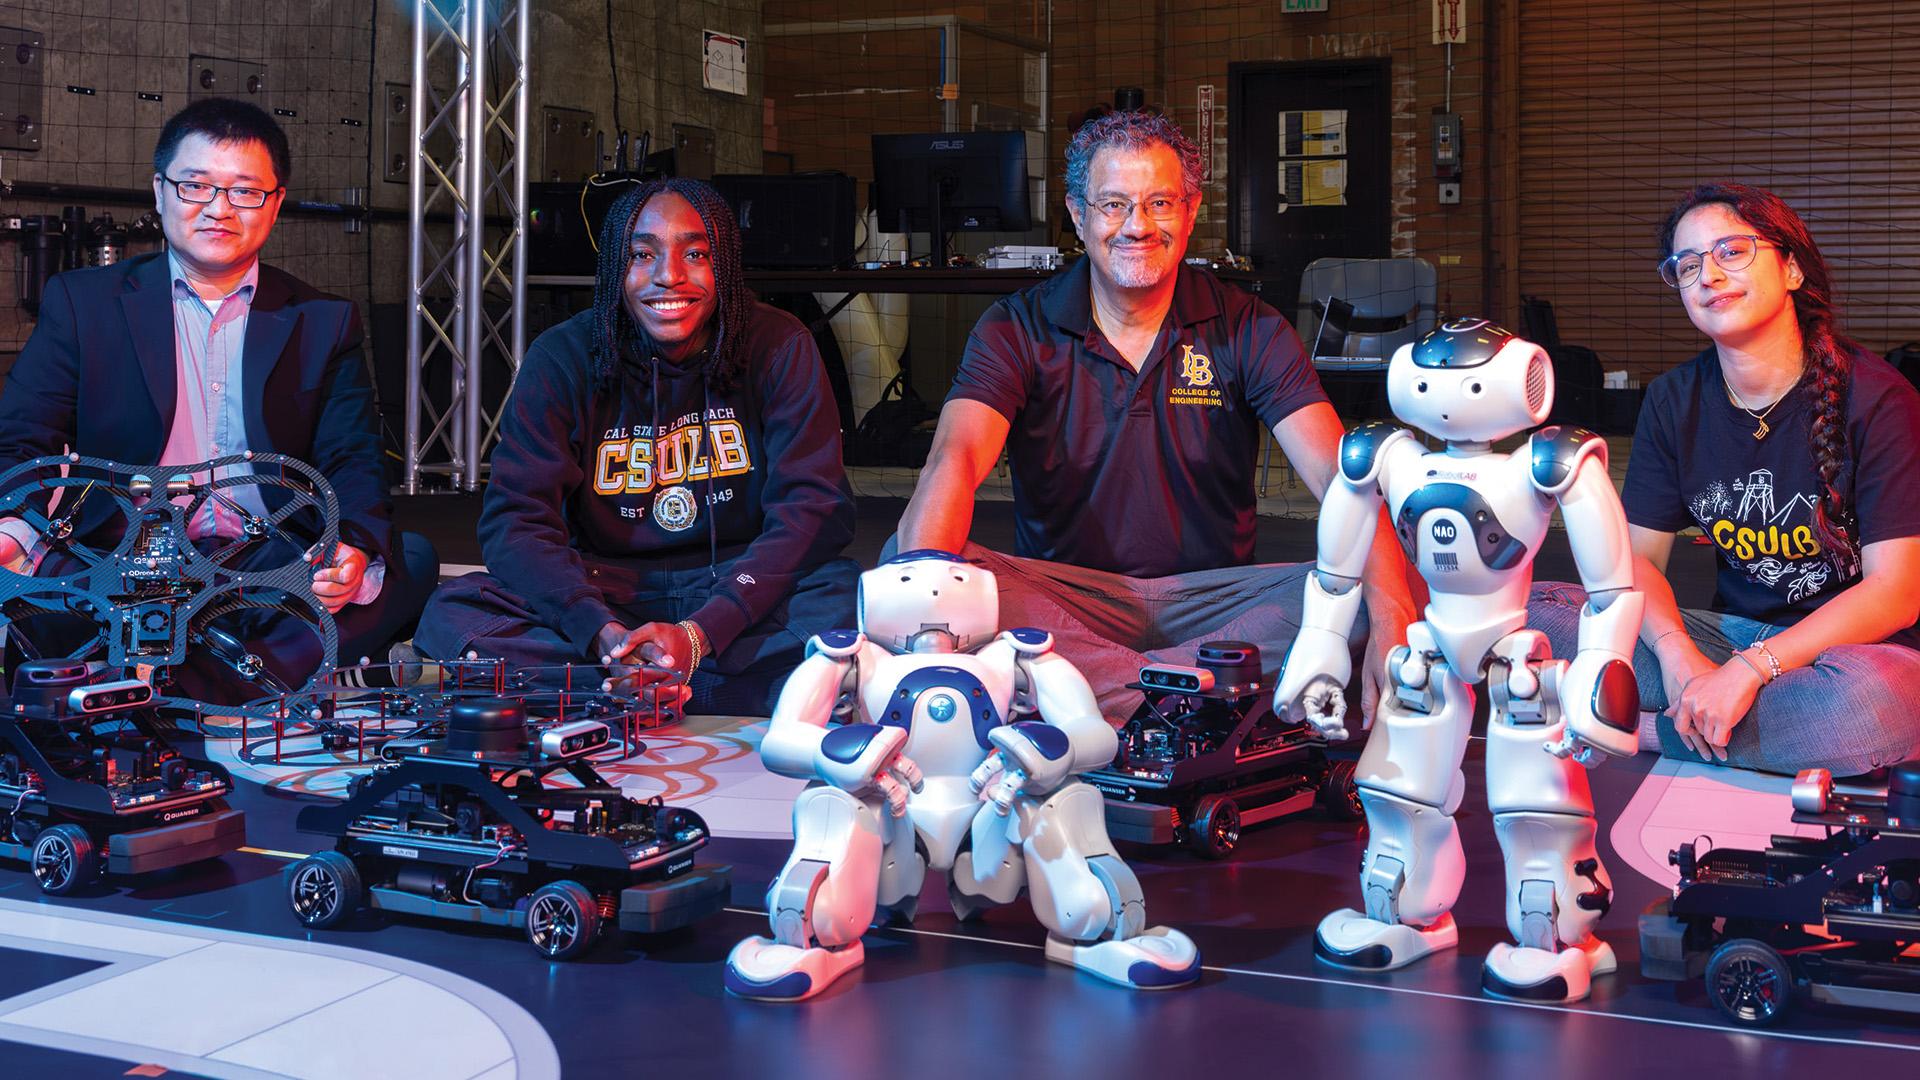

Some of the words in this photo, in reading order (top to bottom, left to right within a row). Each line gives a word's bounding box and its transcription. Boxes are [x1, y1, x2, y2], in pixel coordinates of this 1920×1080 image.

[929, 140, 964, 150] ASUS
[1172, 388, 1208, 396] COLLEGE
[1169, 397, 1222, 406] ENGINEERING
[604, 427, 628, 439] CAL
[633, 425, 667, 437] STAE
[671, 412, 699, 431] LONG
[593, 419, 751, 495] CSULB
[620, 506, 645, 518] EST
[1434, 526, 1455, 538] NAO
[1713, 520, 1821, 560] CSULB
